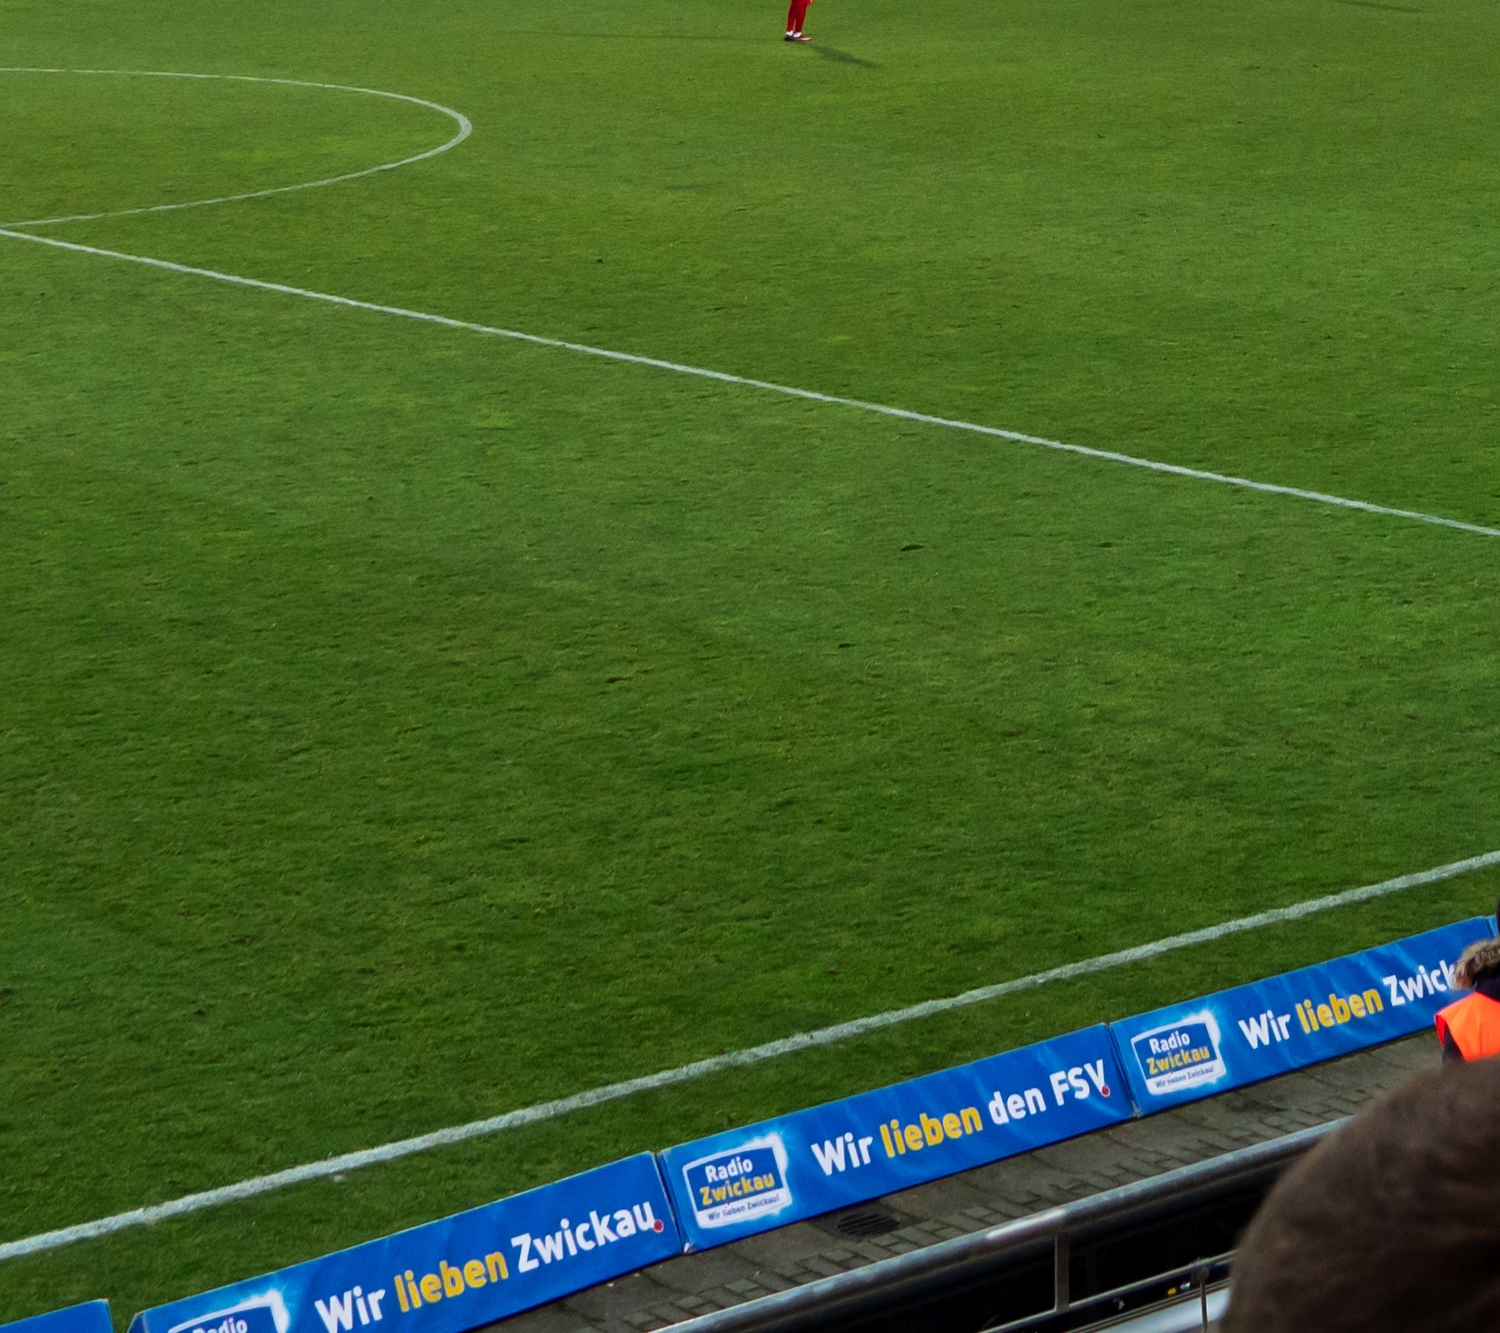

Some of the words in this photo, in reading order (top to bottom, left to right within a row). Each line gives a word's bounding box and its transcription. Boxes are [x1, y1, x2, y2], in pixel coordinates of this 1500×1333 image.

[1238, 1003, 1292, 1051] Wir
[1295, 984, 1385, 1035] lieben
[1382, 959, 1457, 1008] Zwick
[1148, 1030, 1191, 1056] Radio
[1145, 1045, 1211, 1076] Zwickau
[810, 1125, 873, 1176] Wir
[879, 1101, 984, 1158] lieben
[988, 1082, 1047, 1126] den
[704, 1155, 754, 1184] Radio
[699, 1172, 776, 1206] Zwickau
[314, 1285, 386, 1333] Wir
[394, 1251, 510, 1313] lieben
